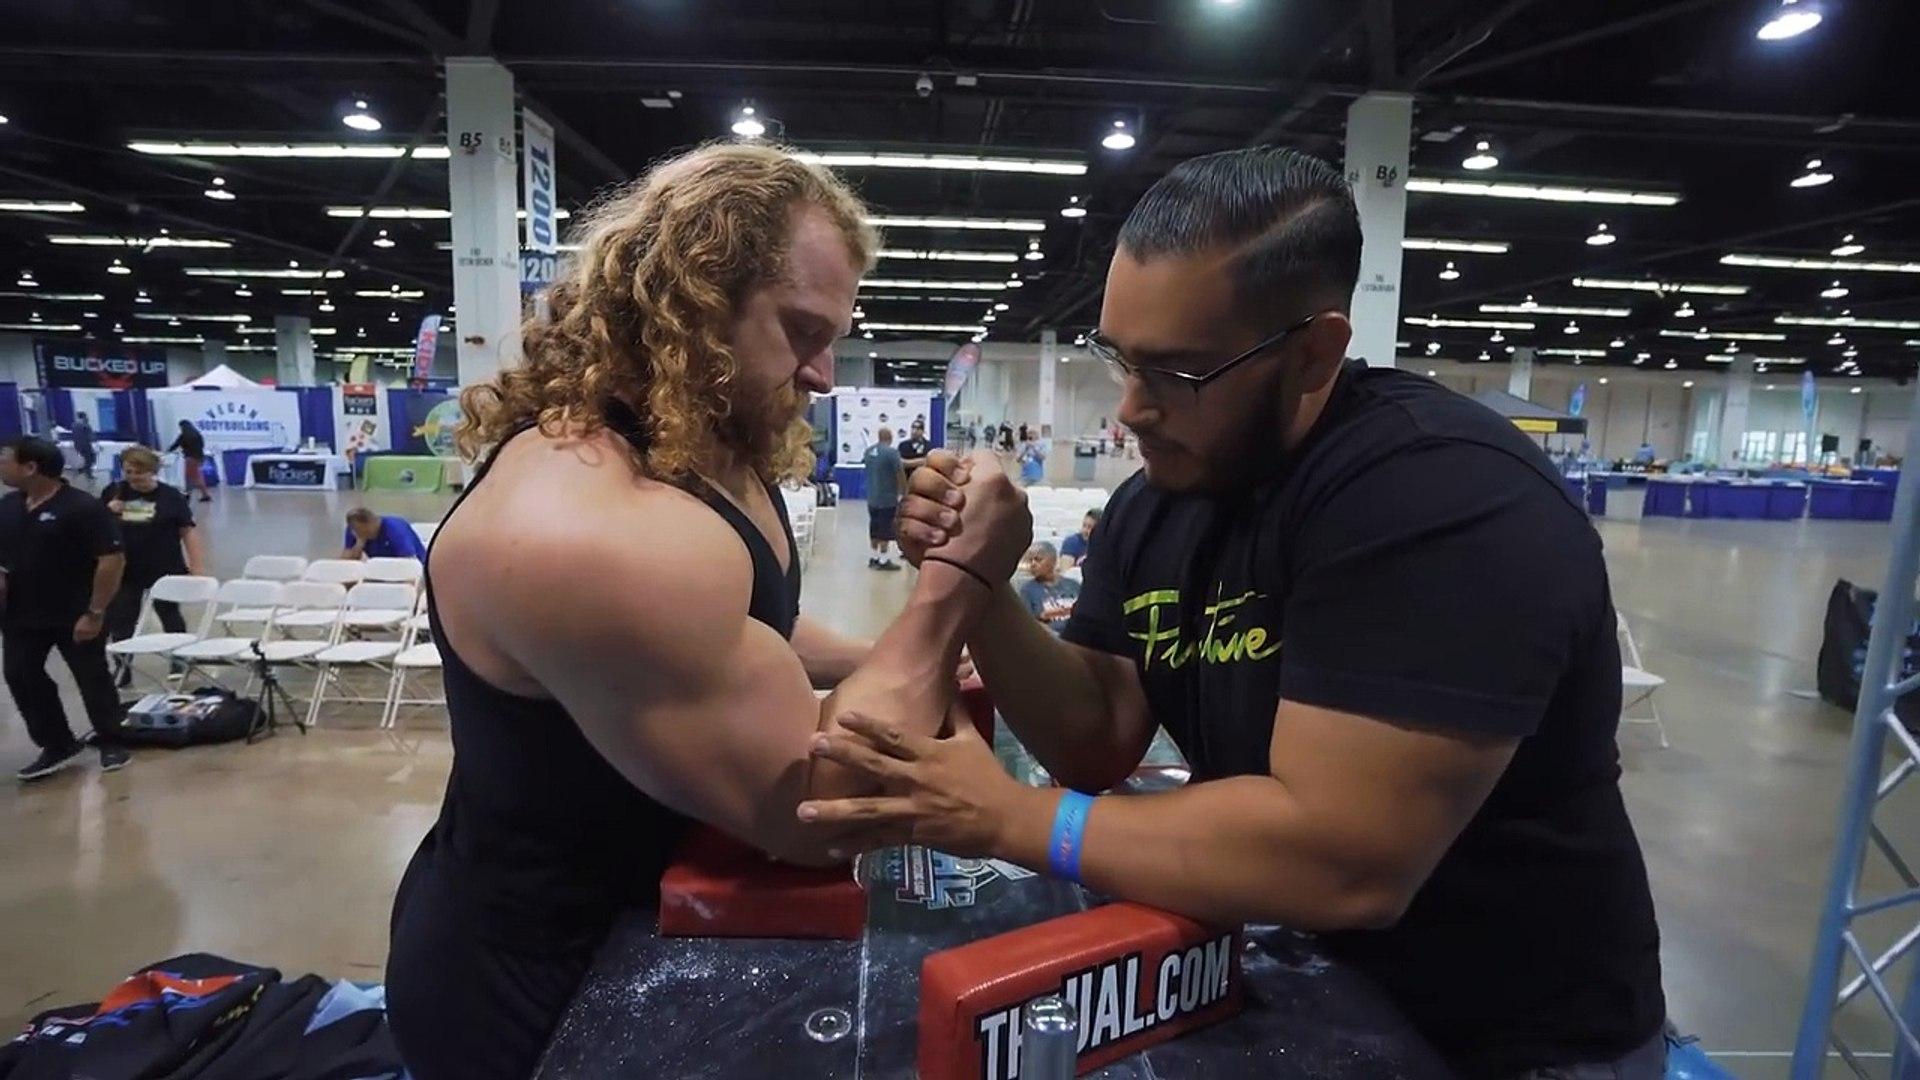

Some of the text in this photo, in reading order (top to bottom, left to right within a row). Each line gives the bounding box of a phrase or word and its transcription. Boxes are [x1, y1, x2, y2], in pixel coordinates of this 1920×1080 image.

[460, 132, 482, 147] B5
[1376, 165, 1397, 180] B6
[531, 145, 551, 246] 1200
[54, 356, 166, 374] BUCKED UP
[206, 402, 259, 420] VEGAN
[980, 935, 1232, 1080] THUAL.COM
